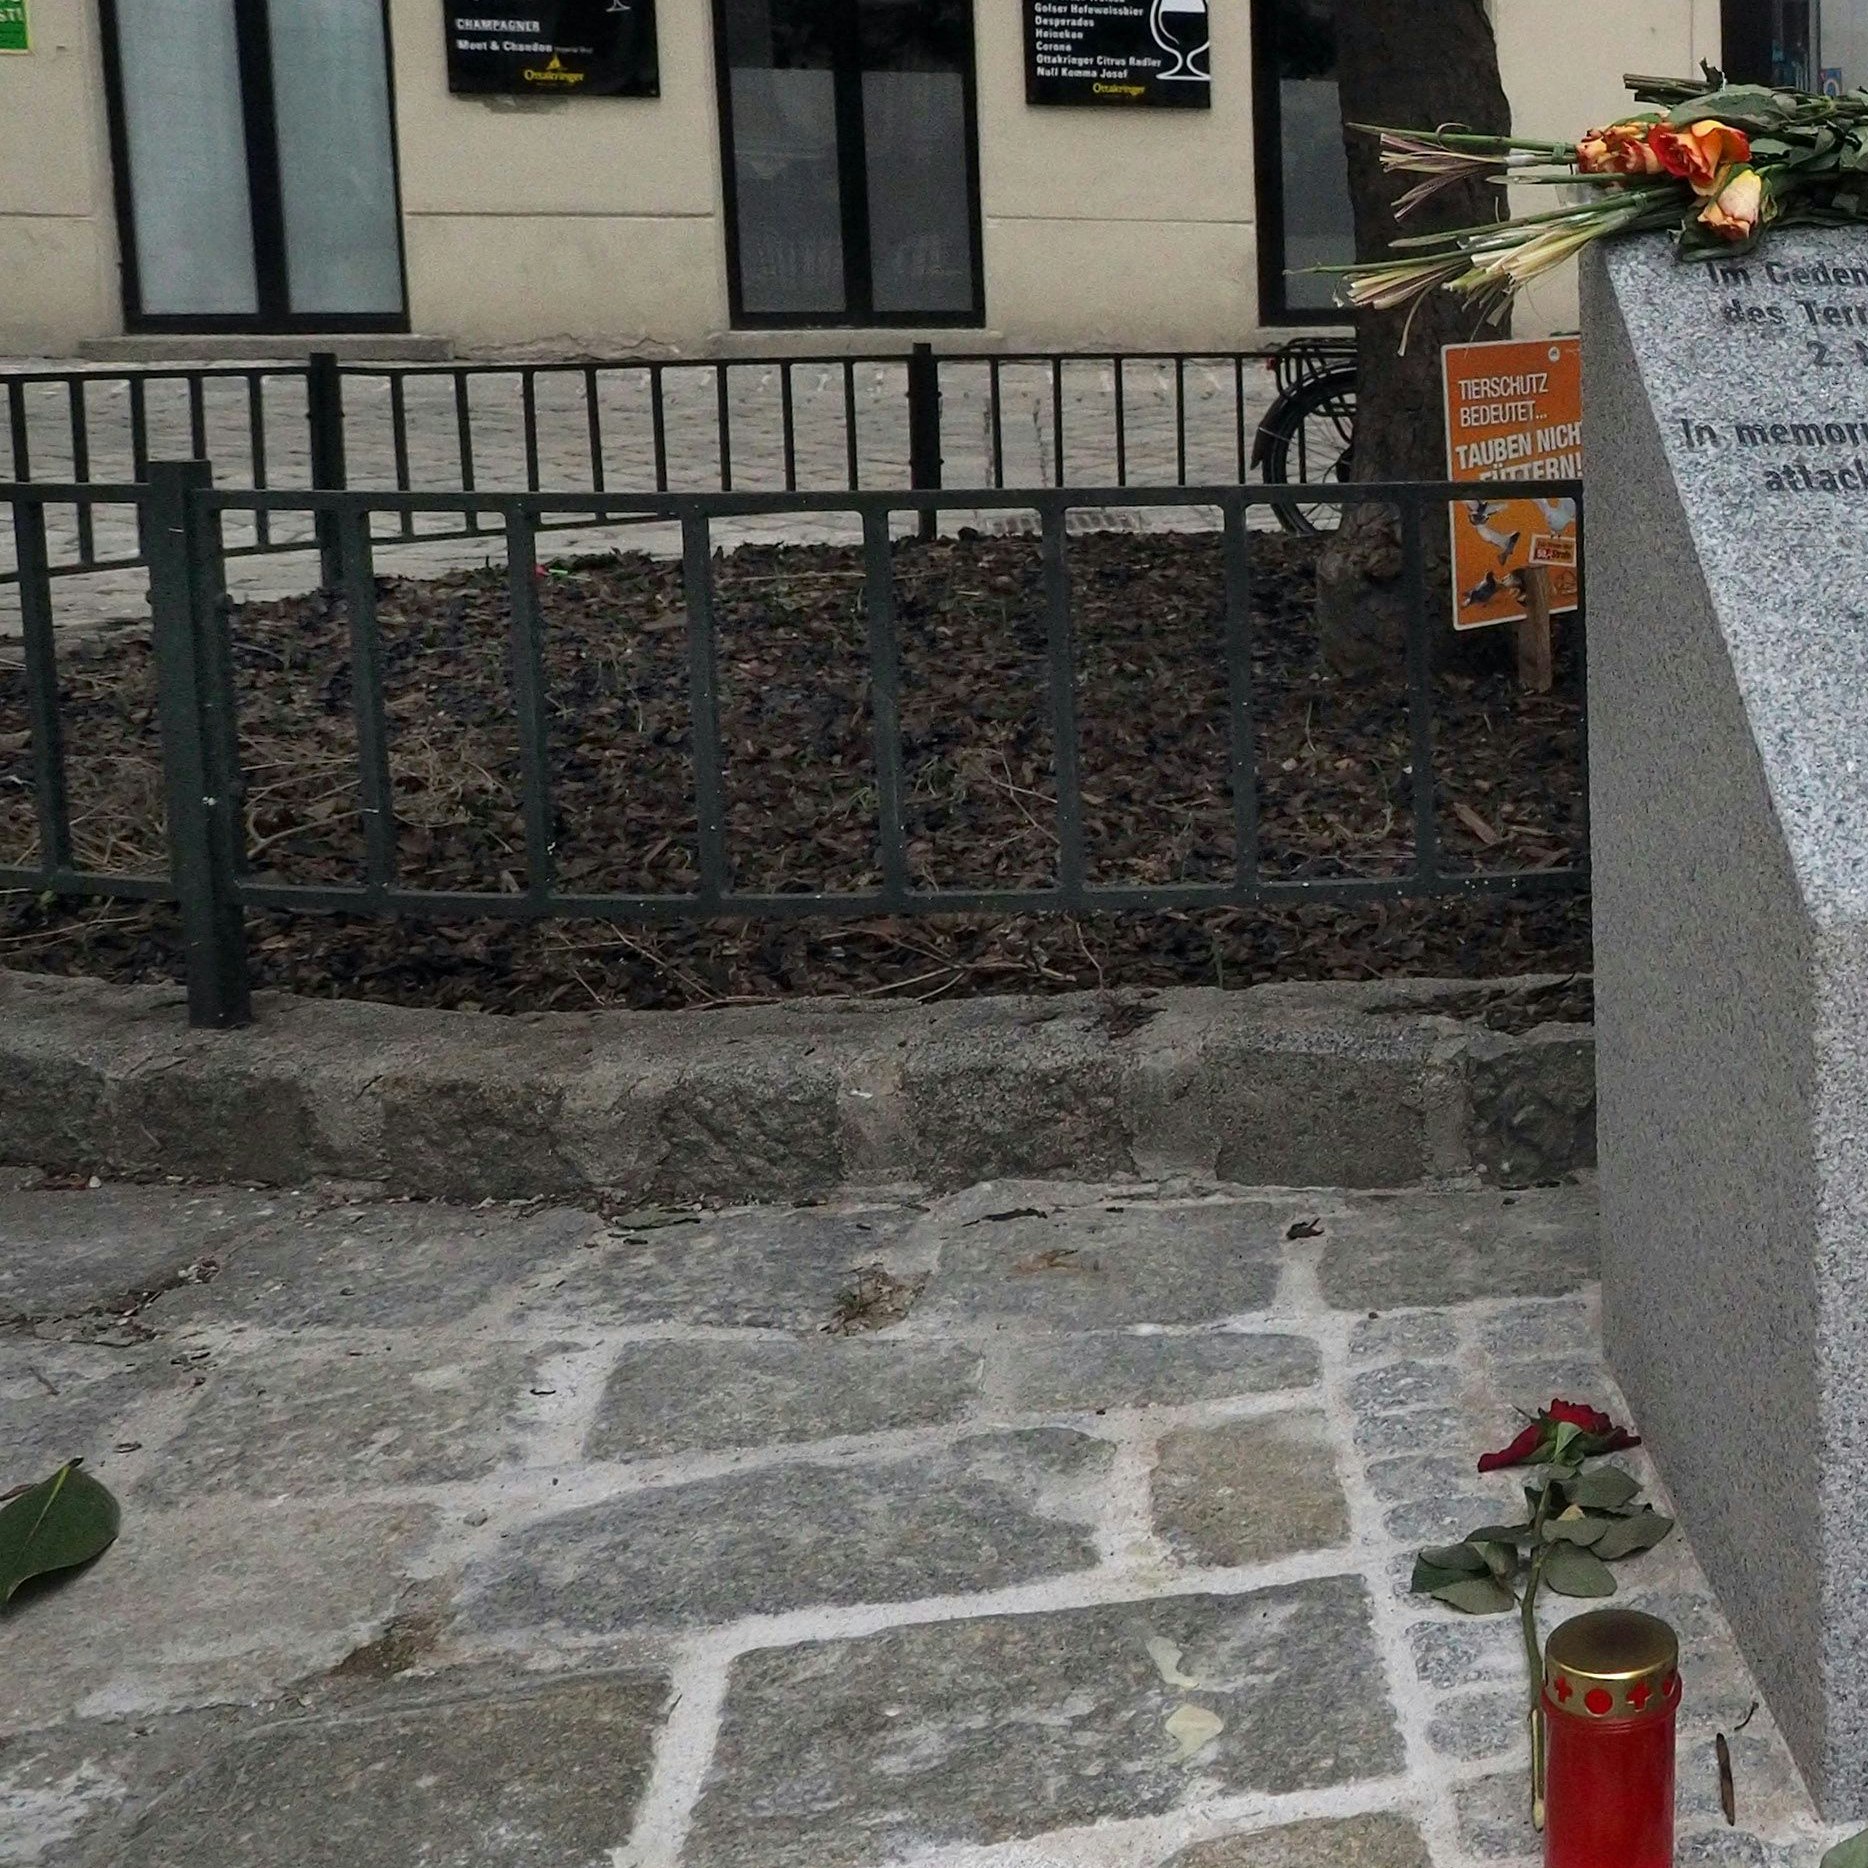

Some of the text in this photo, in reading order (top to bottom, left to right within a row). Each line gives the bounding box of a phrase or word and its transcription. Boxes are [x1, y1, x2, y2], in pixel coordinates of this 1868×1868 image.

[455, 18, 541, 32] CHAMPAGNER
[1035, 15, 1095, 27] Desperados
[1035, 28, 1084, 39] Heineken
[489, 41, 500, 51] &
[502, 41, 553, 52] Chandon
[1036, 41, 1072, 52] Corona
[1036, 54, 1162, 67] Ottakringer Citrus Radler
[1037, 66, 1128, 79] Null Komma Josef
[1705, 261, 1751, 287] Im
[1723, 298, 1786, 326] des
[1806, 340, 1844, 368] 2.
[1458, 373, 1549, 400] TIERSCHUTZ
[1460, 400, 1548, 428] BEDEUTET...
[1680, 417, 1717, 449] In
[1455, 420, 1582, 471] TAUBEN NICH
